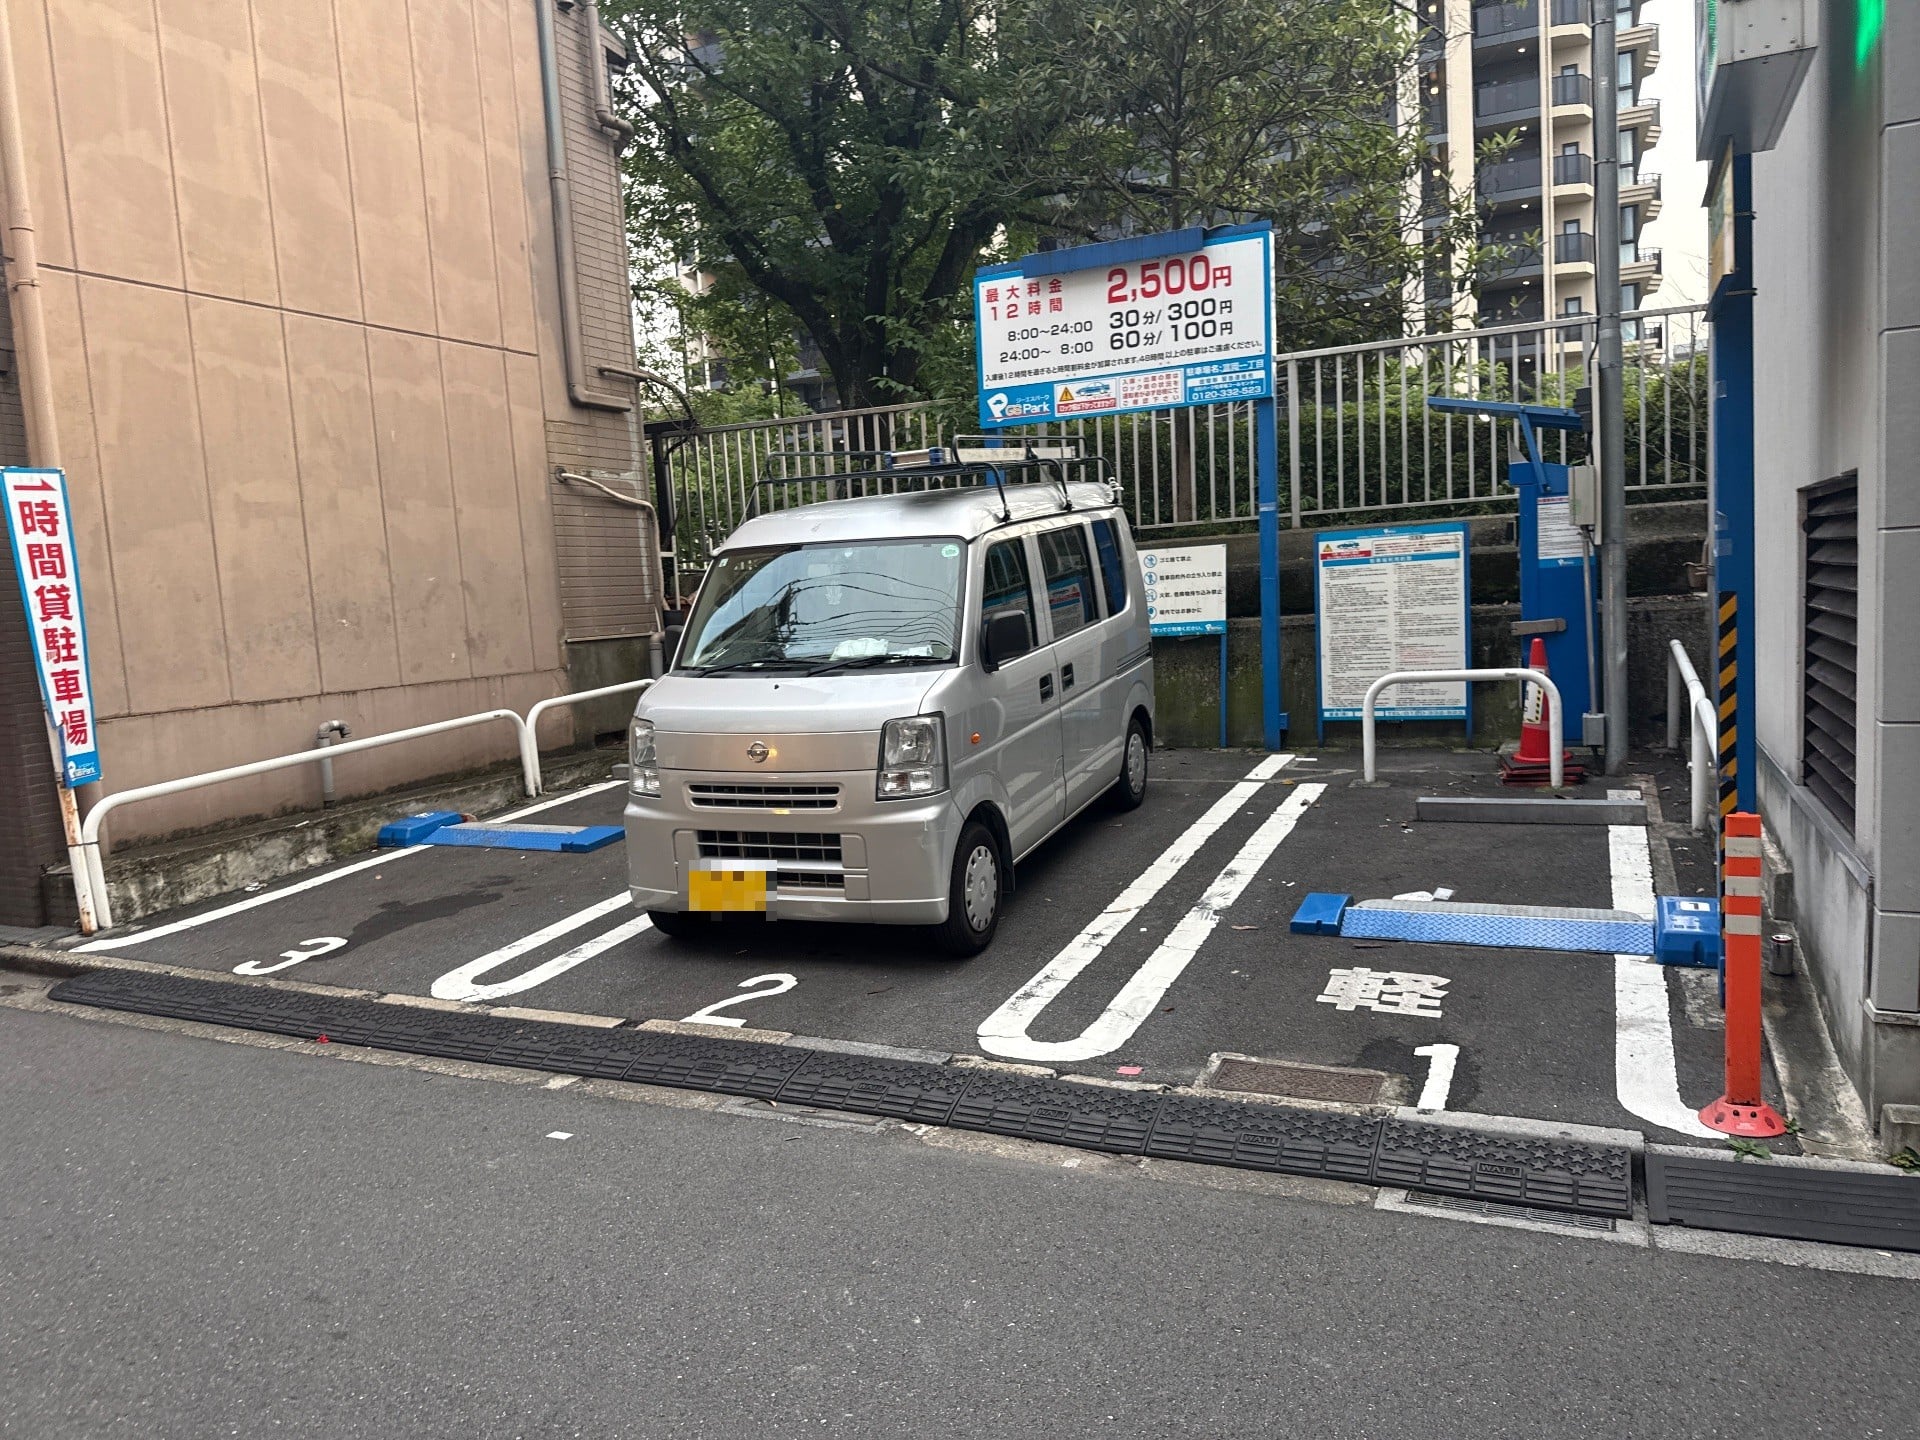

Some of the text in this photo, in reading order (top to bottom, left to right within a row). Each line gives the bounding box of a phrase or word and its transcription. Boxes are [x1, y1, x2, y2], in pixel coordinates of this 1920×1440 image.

[986, 279, 1063, 303] 最大料金
[1107, 254, 1233, 304] 2,500円
[991, 298, 1063, 321] 12時間
[1192, 385, 1262, 400] 0120-332-523
[18, 500, 88, 746] 時間貸駐車場
[232, 936, 349, 975] 3
[681, 973, 798, 1028] 2
[1414, 1043, 1460, 1110] 1
